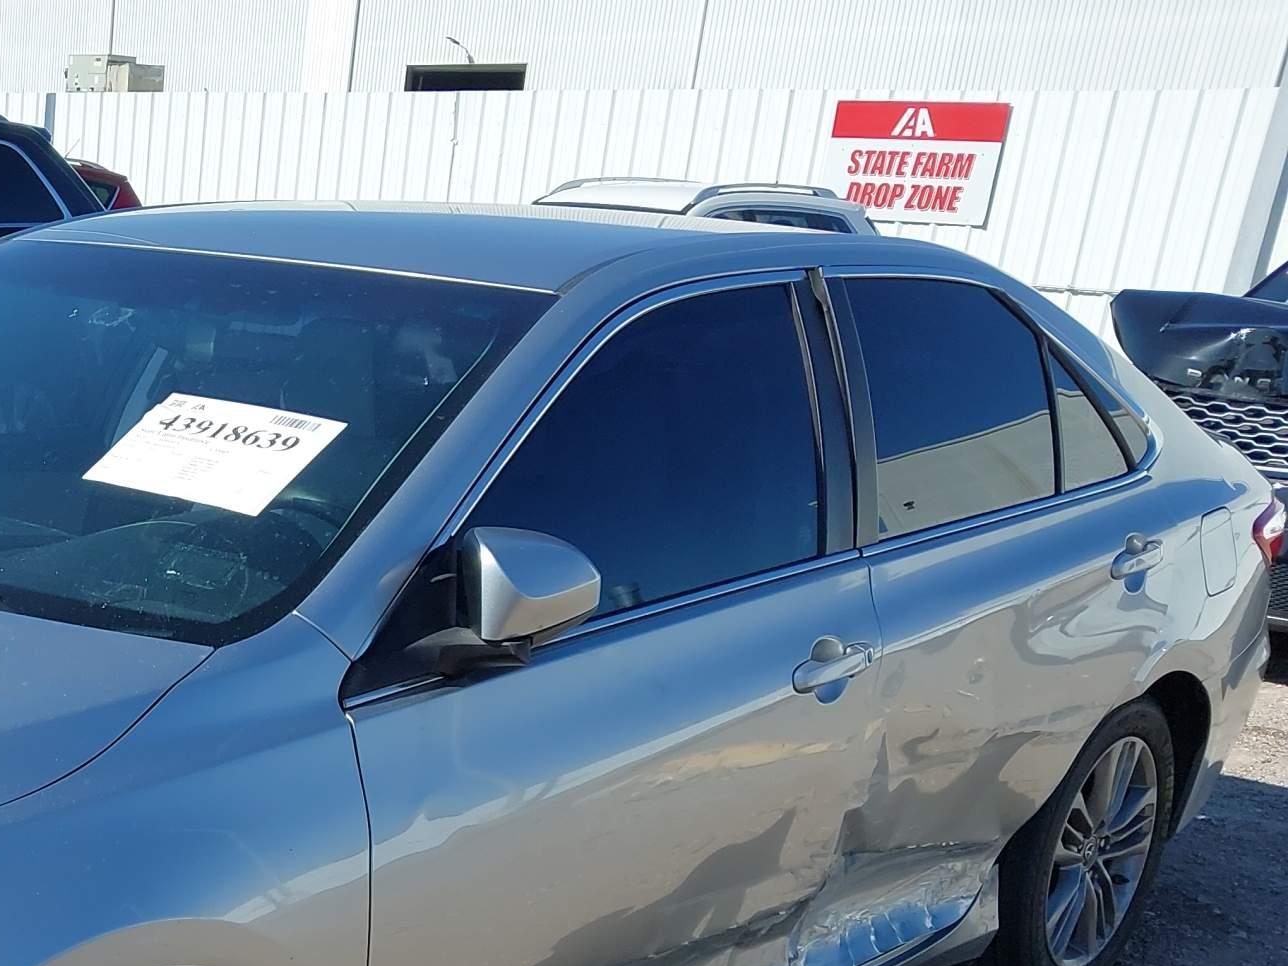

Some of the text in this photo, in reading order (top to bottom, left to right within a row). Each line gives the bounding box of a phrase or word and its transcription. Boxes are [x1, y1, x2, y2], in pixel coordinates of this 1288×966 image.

[847, 150, 976, 180] STATE FARM
[846, 182, 963, 213] DROP ZONE
[159, 414, 301, 452] 43918639
